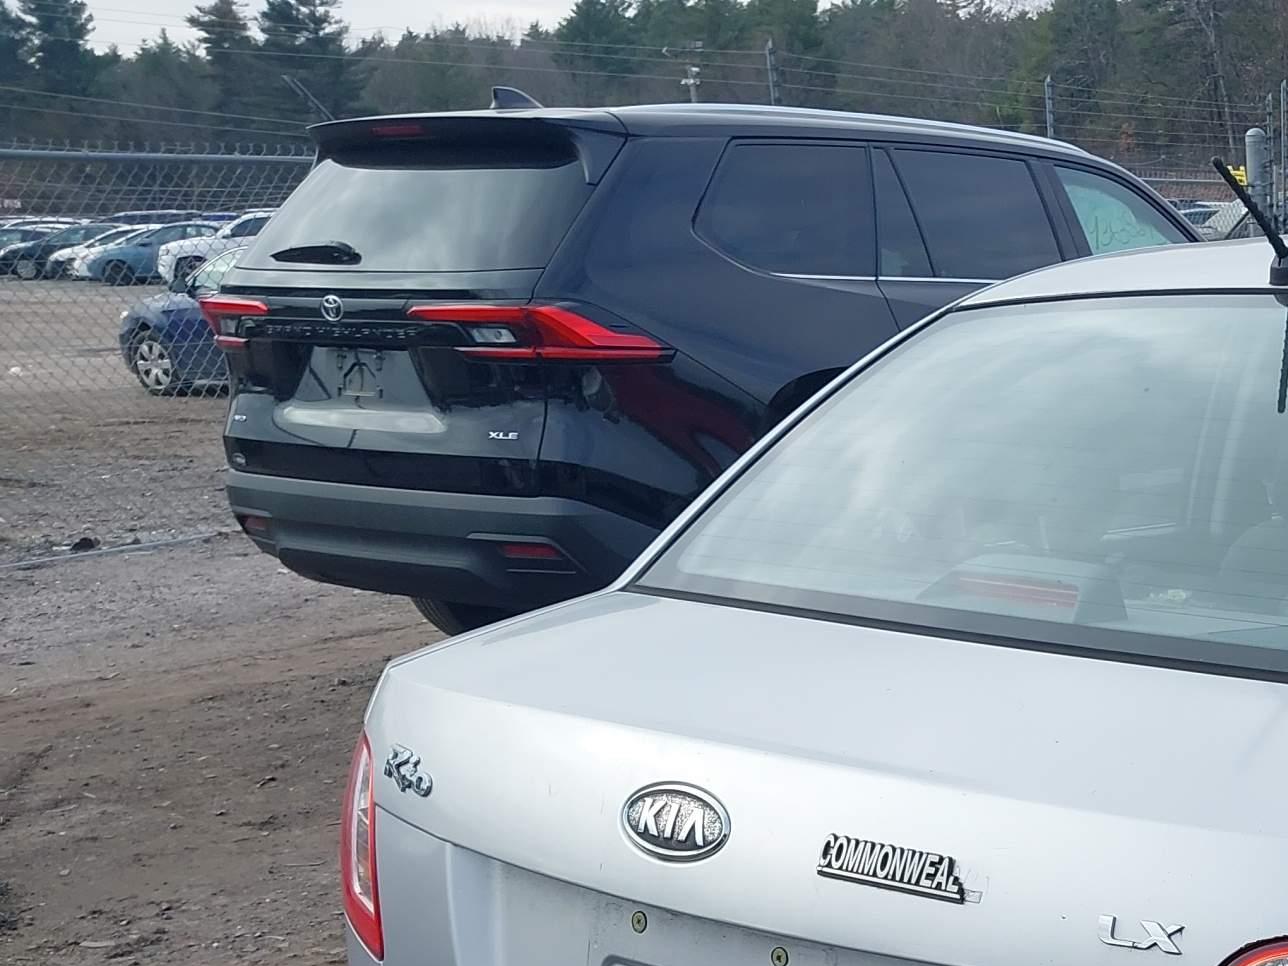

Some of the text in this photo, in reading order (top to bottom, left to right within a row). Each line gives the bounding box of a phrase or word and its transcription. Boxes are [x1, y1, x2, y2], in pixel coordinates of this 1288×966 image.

[488, 431, 519, 440] XLE
[384, 743, 433, 798] Rio
[638, 797, 705, 846] KIA
[1098, 914, 1185, 955] LX
